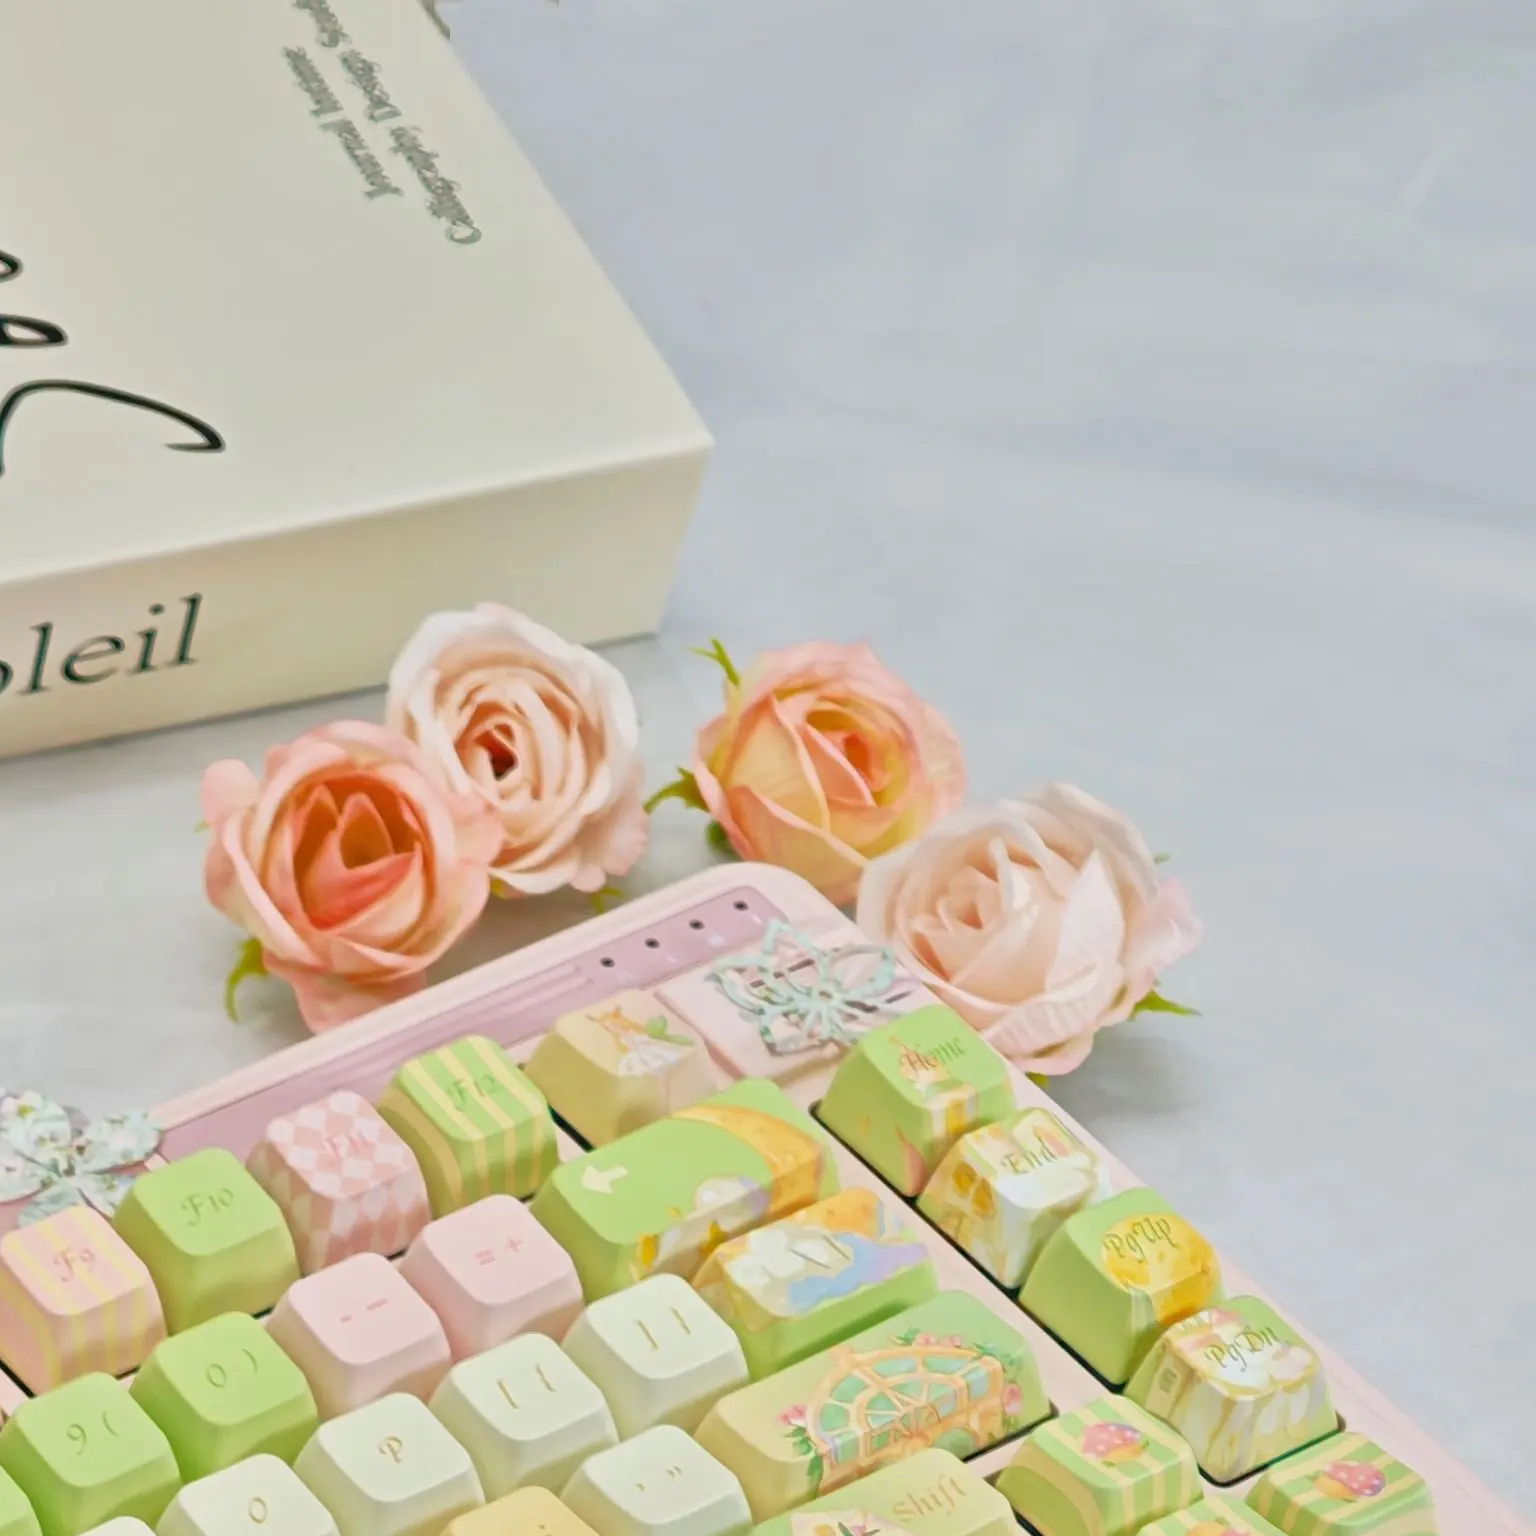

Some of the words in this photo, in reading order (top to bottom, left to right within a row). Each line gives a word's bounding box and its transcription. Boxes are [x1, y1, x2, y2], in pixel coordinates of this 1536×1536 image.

[1001, 1137, 1057, 1177] End
[180, 1187, 234, 1227] F10
[378, 1435, 404, 1464] P
[248, 1496, 268, 1525] O
